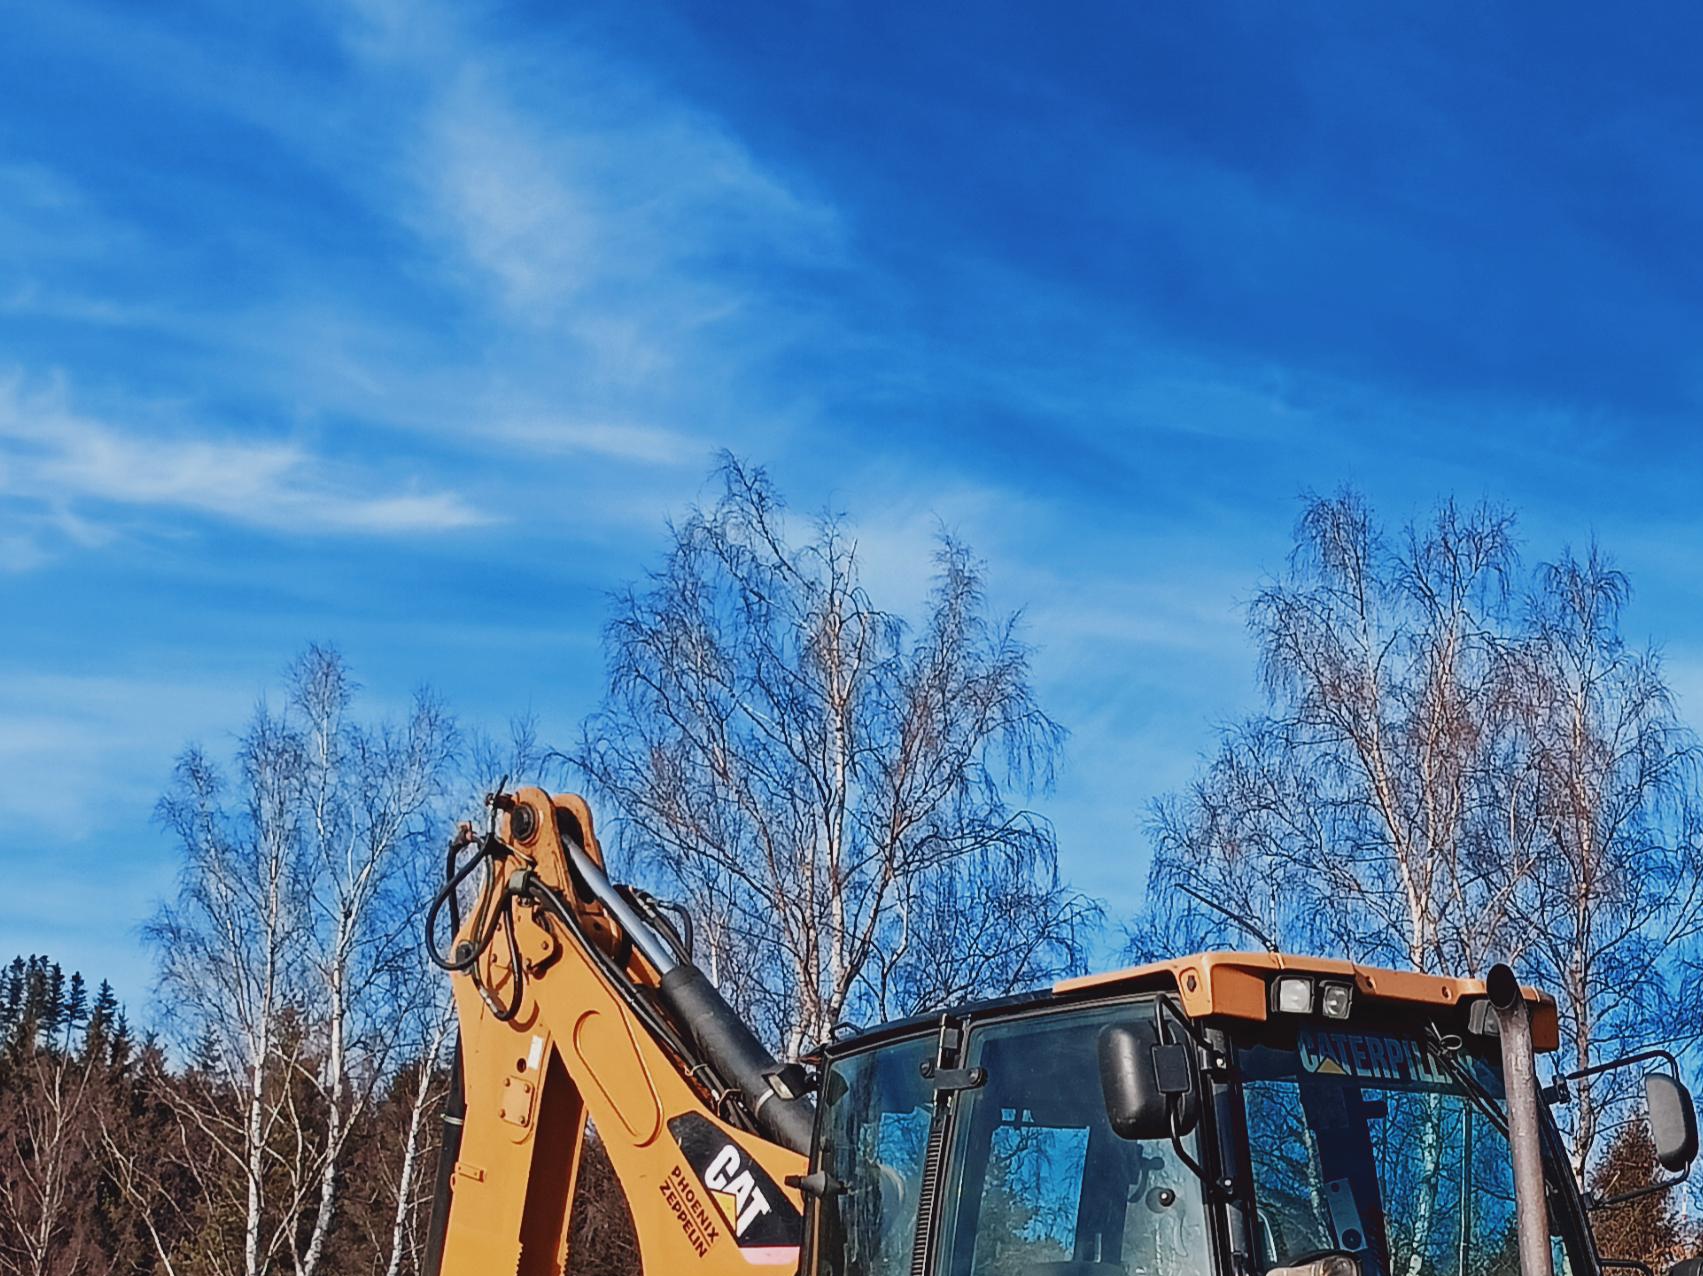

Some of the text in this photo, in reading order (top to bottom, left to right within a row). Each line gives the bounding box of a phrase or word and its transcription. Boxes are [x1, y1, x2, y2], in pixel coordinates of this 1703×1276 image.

[1299, 1030, 1478, 1084] CATERPILL
[659, 1179, 709, 1259] ZEPPELIN
[671, 1165, 719, 1244] PHOENIX
[704, 1144, 772, 1238] CAT
